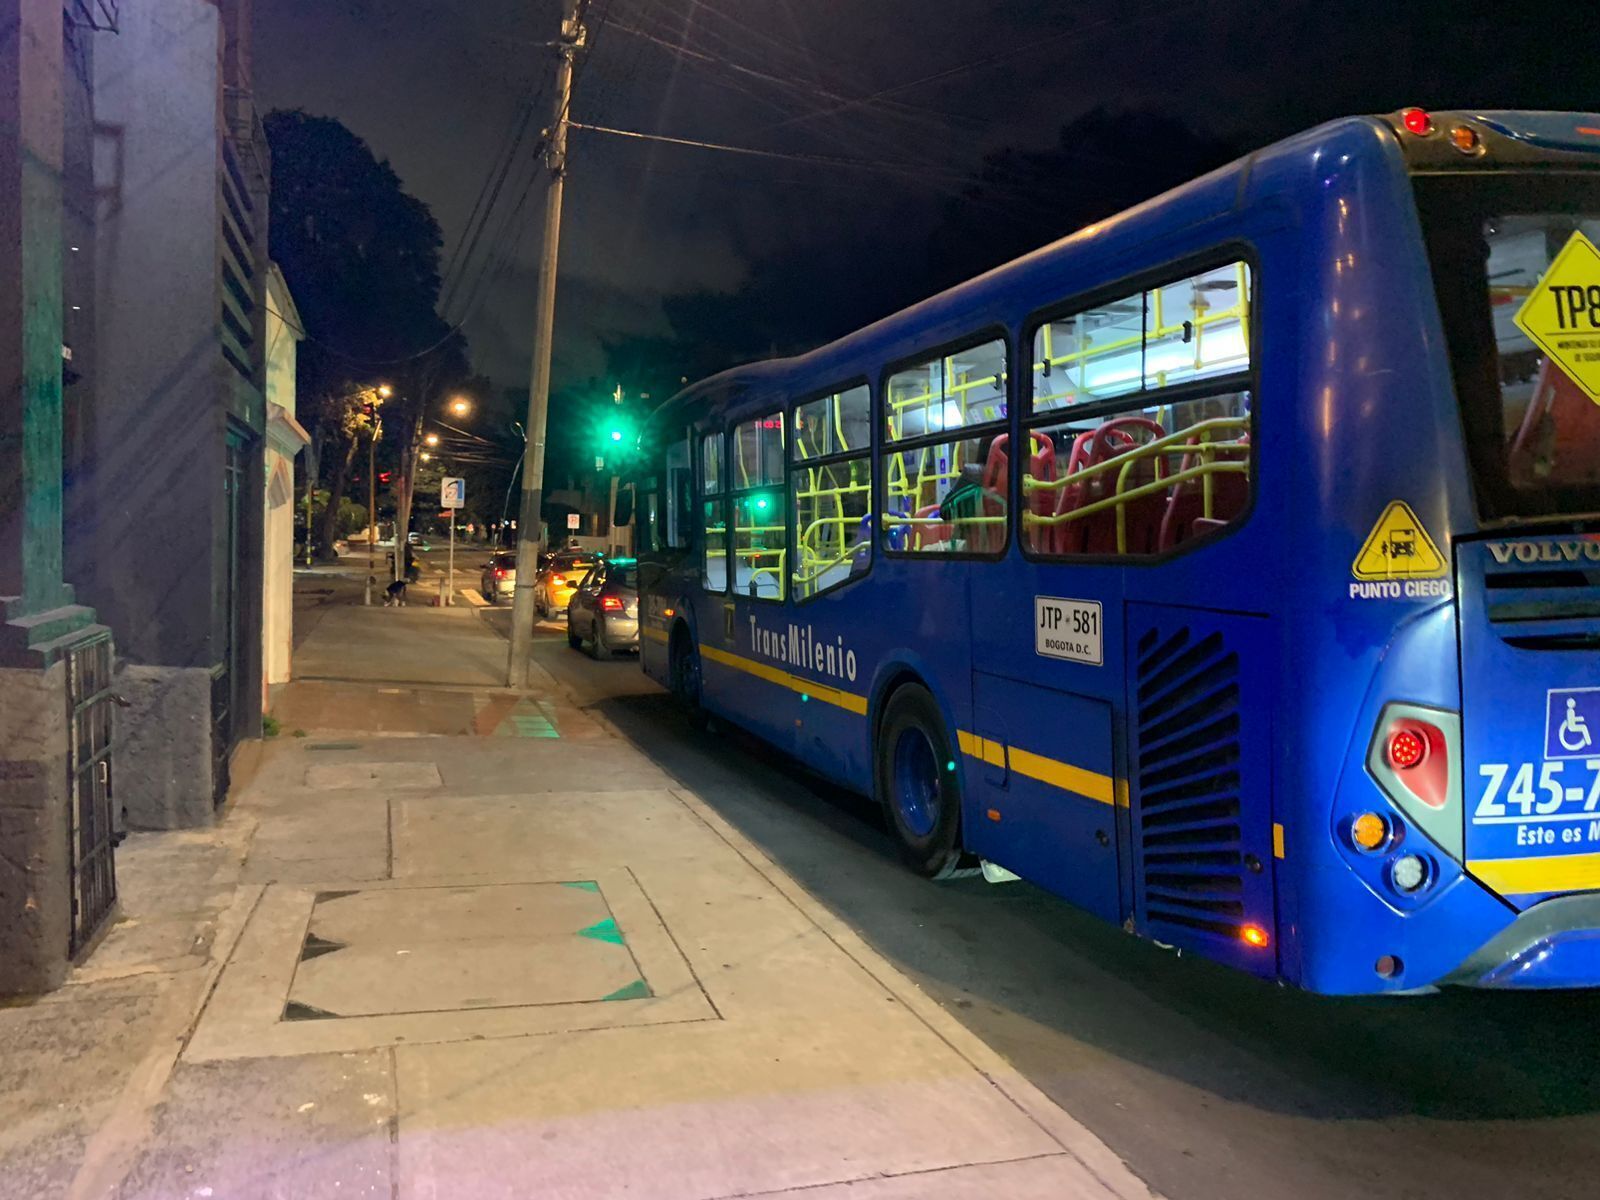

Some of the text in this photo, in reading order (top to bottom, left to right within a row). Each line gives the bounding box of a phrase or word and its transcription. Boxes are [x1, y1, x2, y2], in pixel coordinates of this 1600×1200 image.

[1486, 541, 1600, 564] VOLVO
[1349, 580, 1450, 599] PUNTO CIEGO
[1040, 606, 1097, 635] JTP 581
[749, 615, 857, 682] TransMilenio
[1045, 638, 1091, 655] BOGOTA D.C.
[1474, 759, 1600, 816] Z45-7
[1517, 824, 1555, 846] Este
[1561, 827, 1582, 843] es
